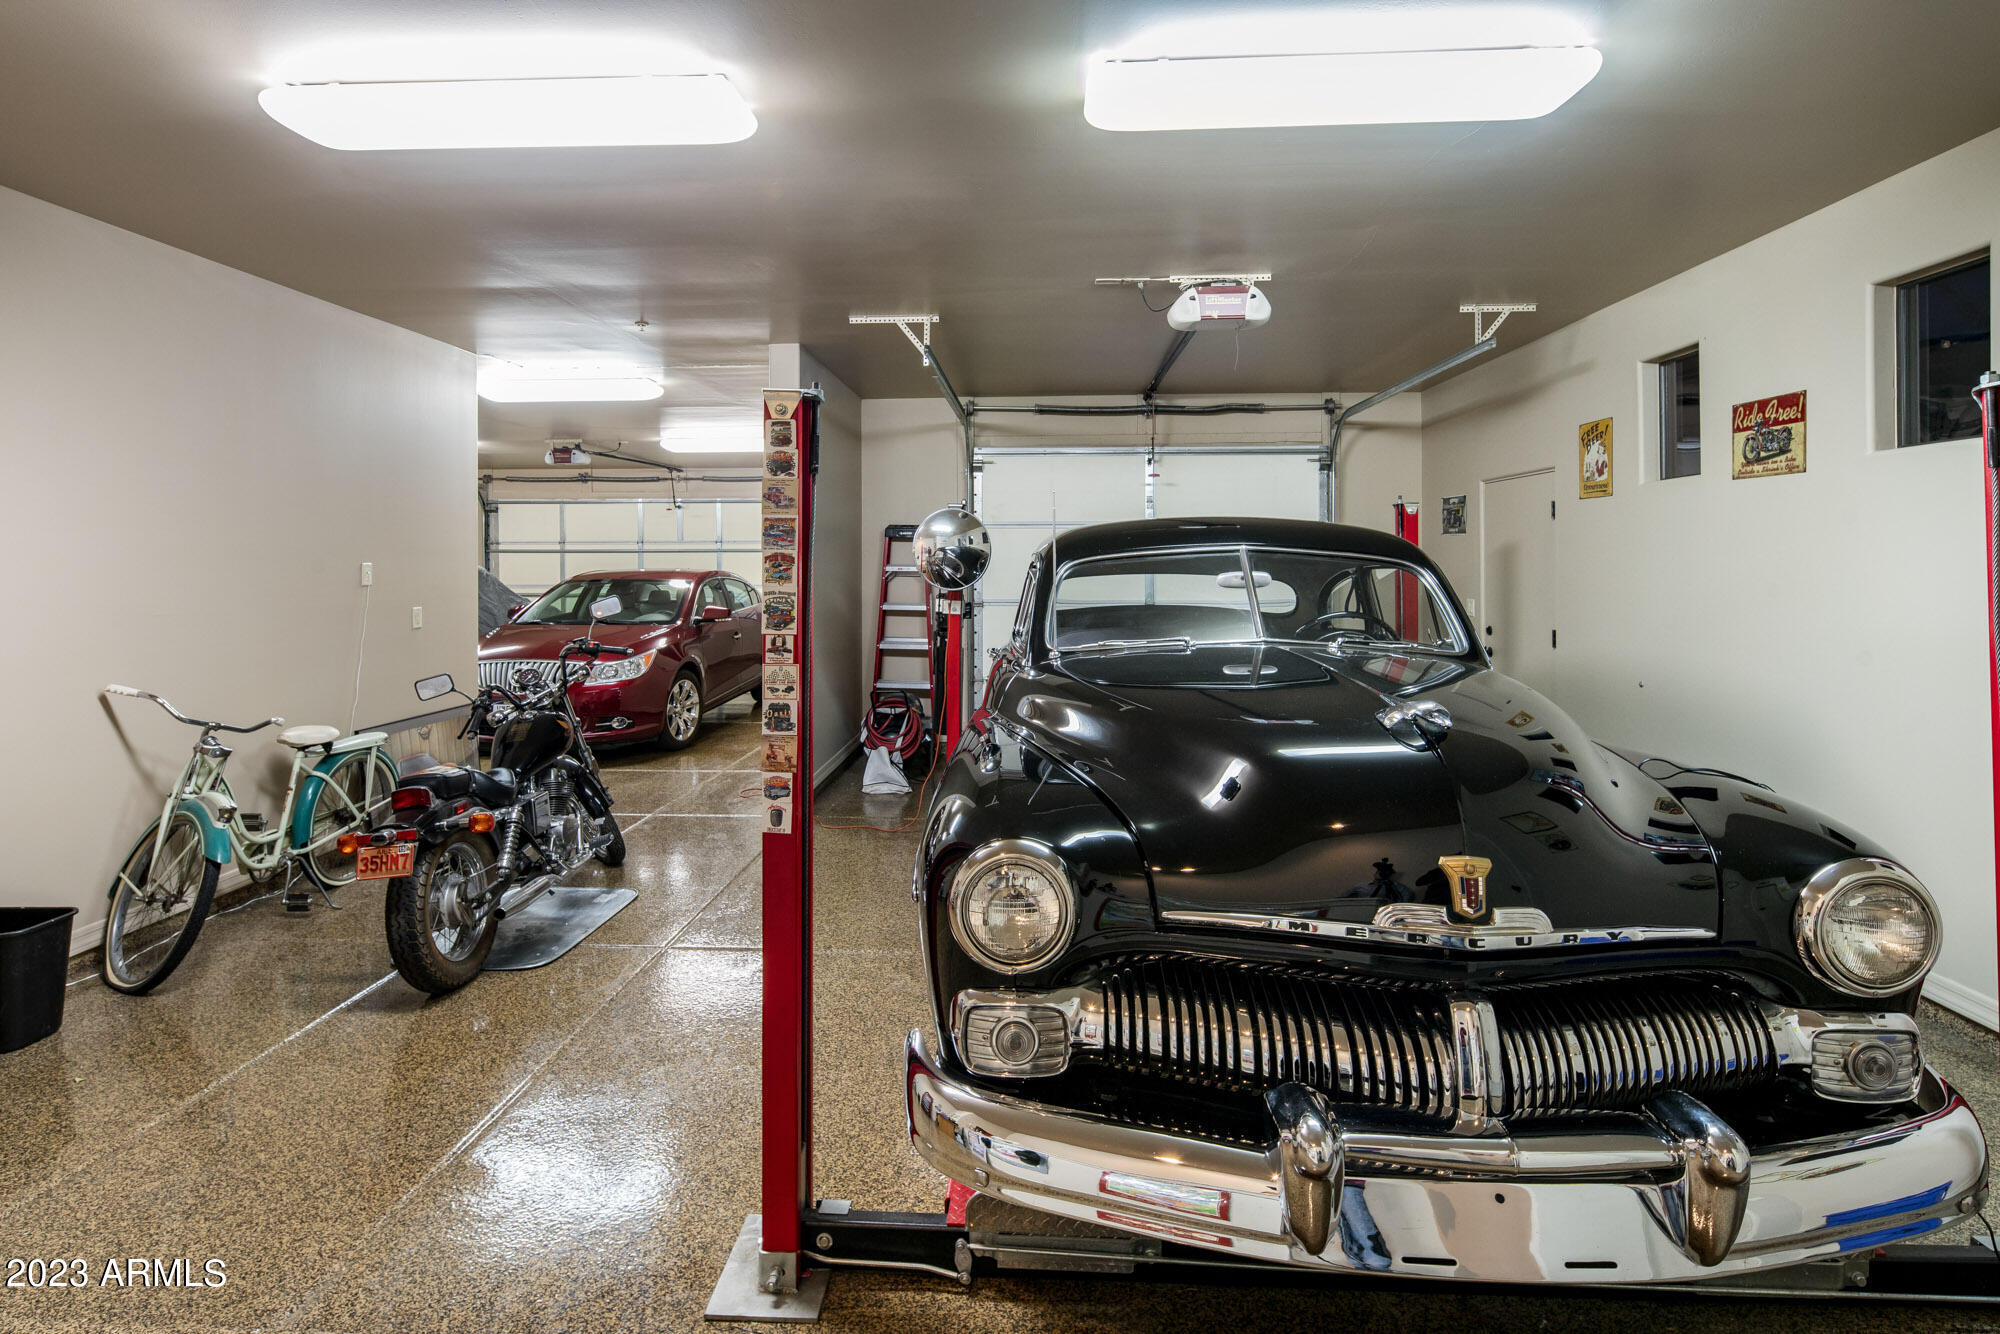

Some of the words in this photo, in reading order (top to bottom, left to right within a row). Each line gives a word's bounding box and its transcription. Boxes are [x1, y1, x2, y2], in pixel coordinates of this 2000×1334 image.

[1734, 402, 1763, 429] Ride
[1765, 394, 1804, 424] Free!
[1581, 422, 1600, 449] FREE
[1288, 920, 1624, 949] MERCURY
